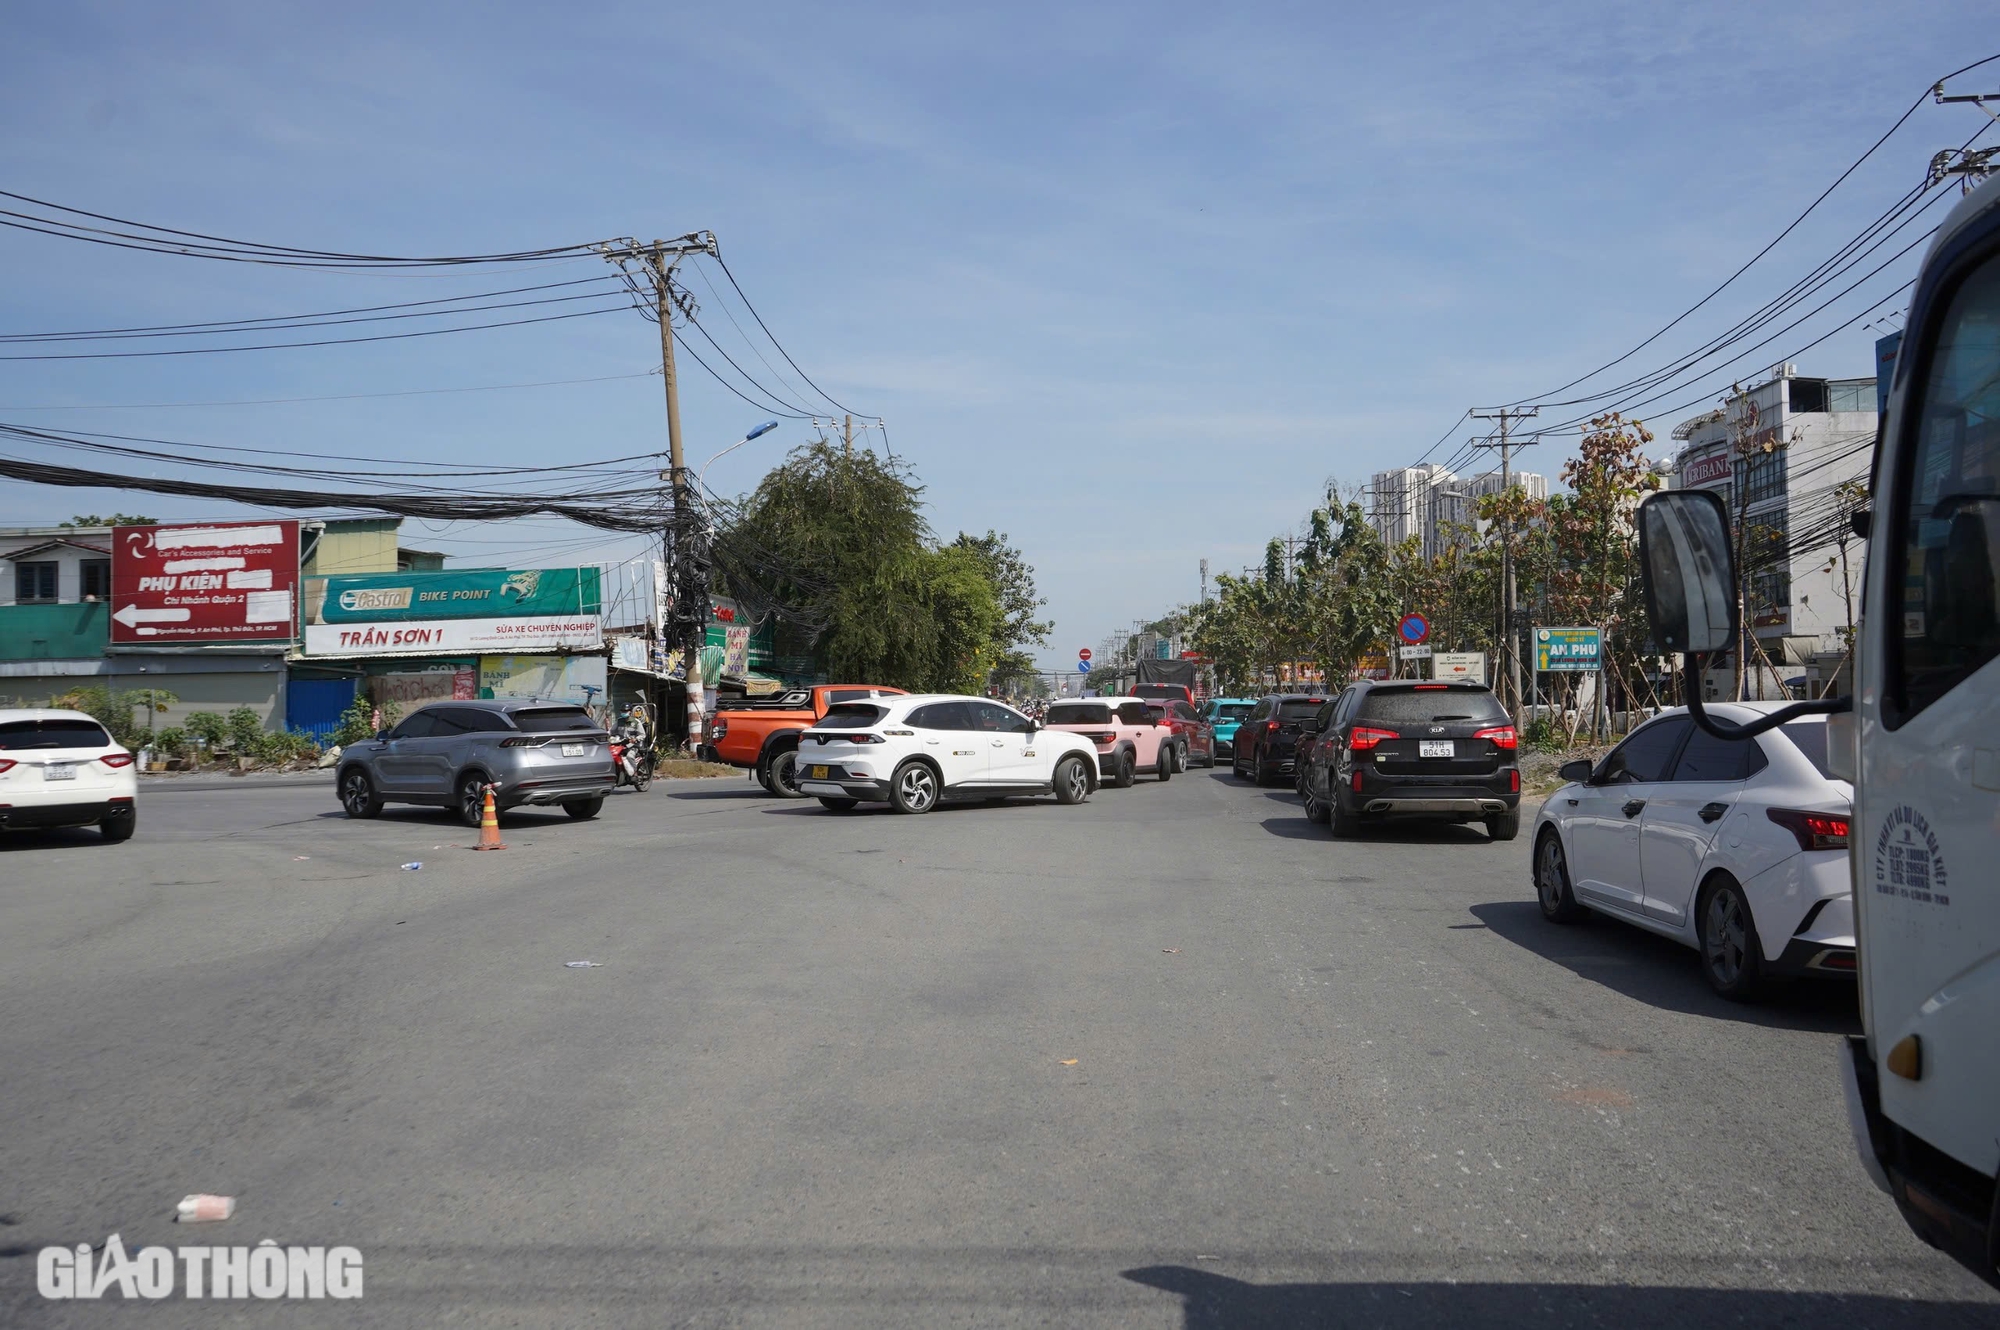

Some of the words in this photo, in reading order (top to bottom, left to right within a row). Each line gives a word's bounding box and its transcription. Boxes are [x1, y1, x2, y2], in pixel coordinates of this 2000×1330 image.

[138, 575, 177, 595] PHỤ
[180, 572, 224, 594] KIỆN
[212, 595, 236, 605] Quận
[358, 589, 407, 607] Castrol
[419, 592, 448, 602] BIKE
[452, 590, 491, 600] POINT
[496, 624, 512, 633] SỬA
[528, 623, 561, 632] CHUYÊN
[564, 622, 595, 631] NGHIỆP
[340, 627, 388, 645] TRẦN
[393, 629, 431, 644] SƠN
[436, 629, 443, 642] 1
[1550, 644, 1567, 655] AN
[1572, 642, 1597, 655] PHÚ
